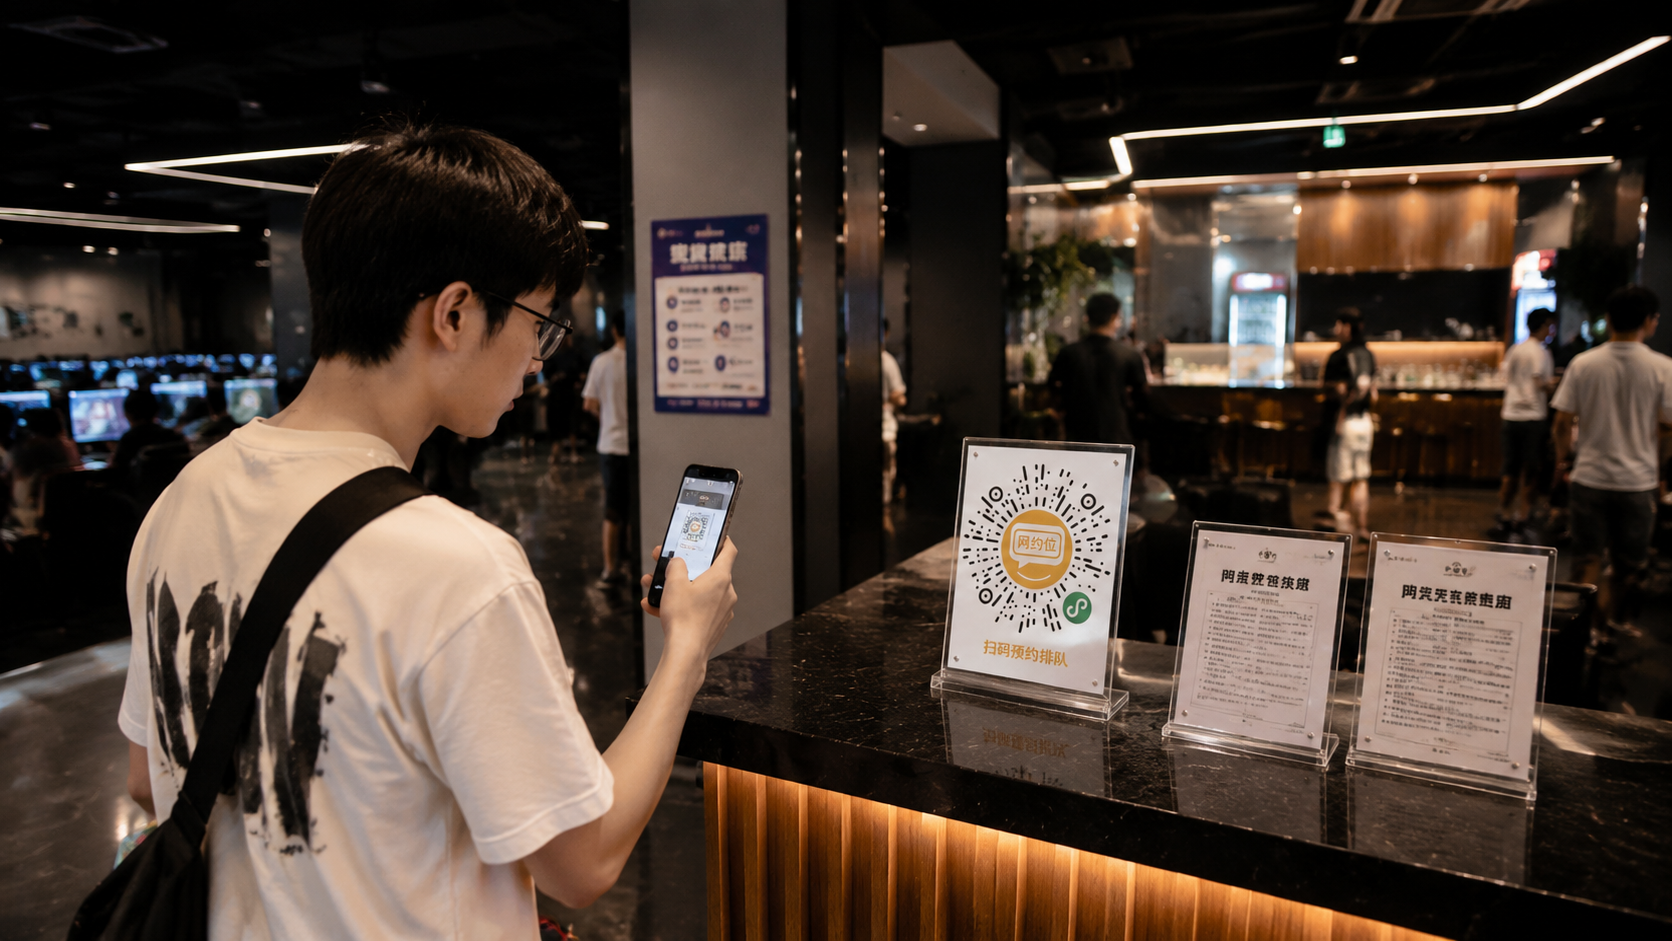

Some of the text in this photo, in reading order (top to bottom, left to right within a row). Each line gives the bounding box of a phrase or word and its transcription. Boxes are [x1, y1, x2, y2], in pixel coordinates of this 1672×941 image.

[1017, 534, 1057, 552] 网约位
[983, 639, 1068, 668] 扫码预约排队
